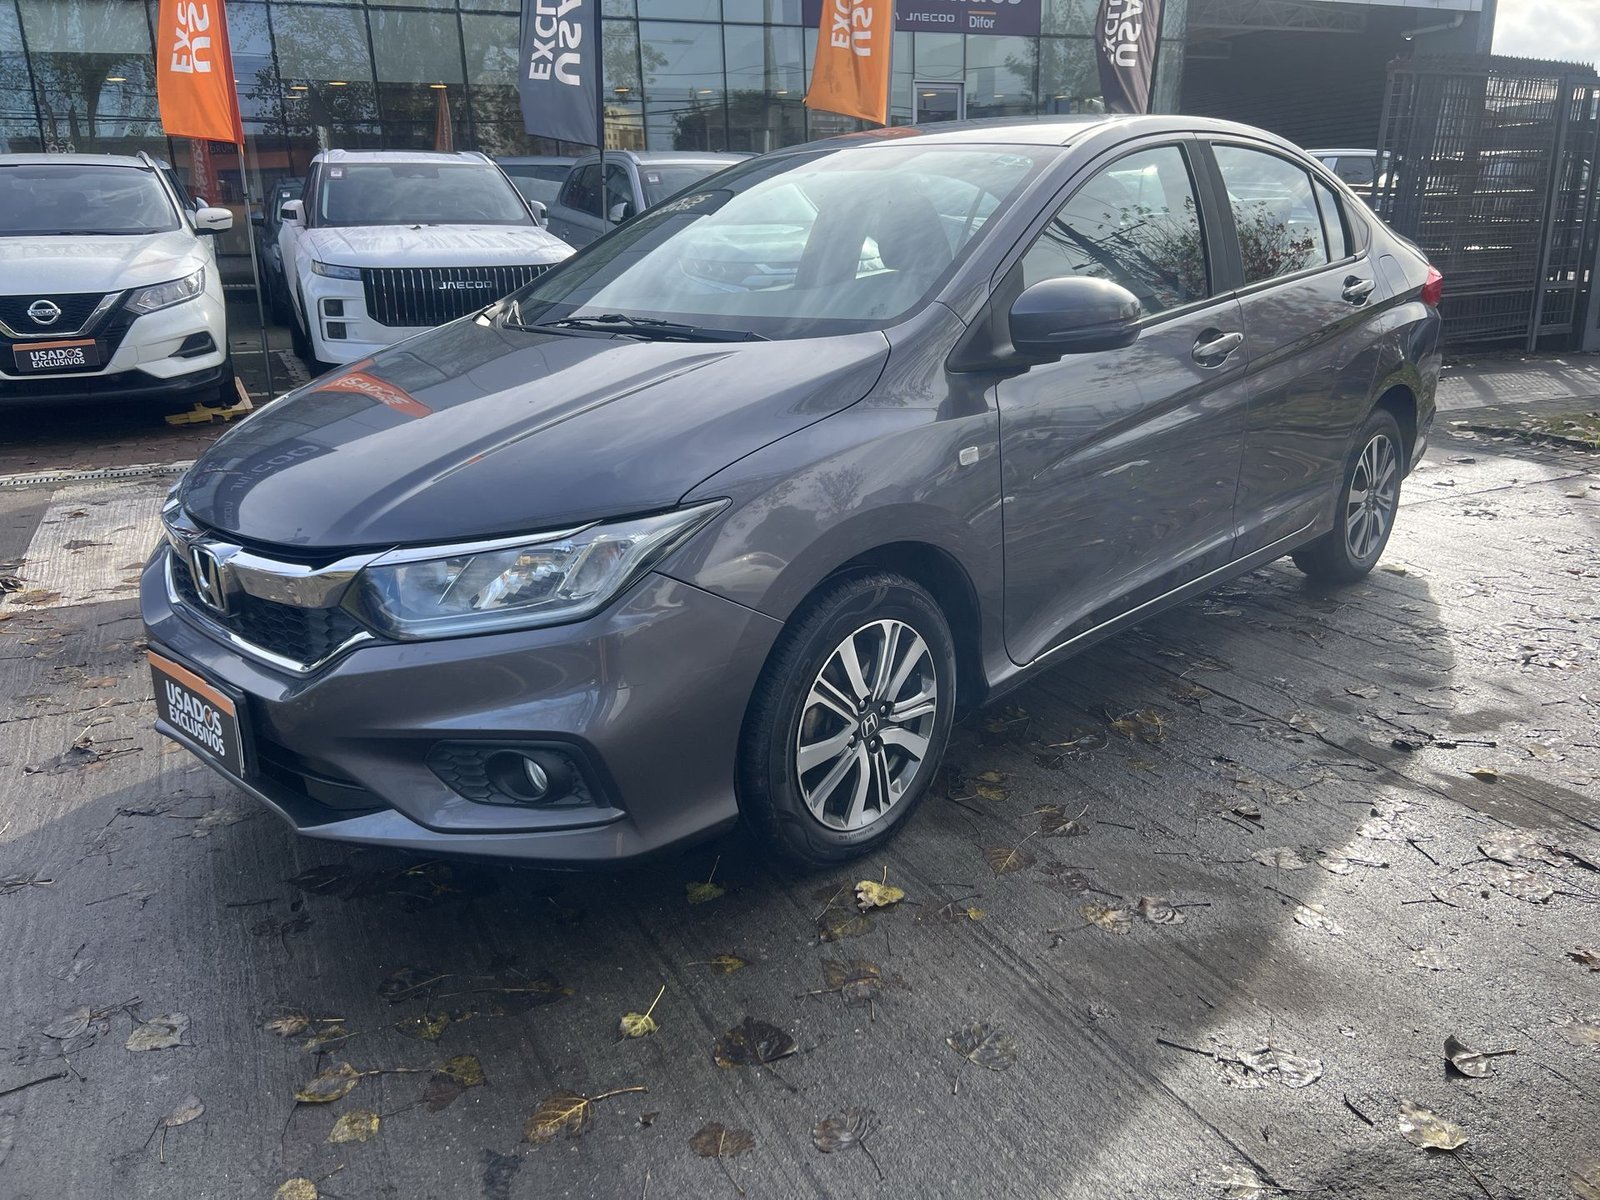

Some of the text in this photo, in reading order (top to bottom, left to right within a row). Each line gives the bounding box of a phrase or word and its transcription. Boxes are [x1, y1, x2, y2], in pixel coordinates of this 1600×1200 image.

[905, 12, 955, 22] JAECOO
[968, 15, 995, 28] Difor
[438, 281, 493, 289] JAECOO
[30, 348, 84, 361] USADOS
[32, 357, 86, 368] EXCLUSIVOS
[165, 680, 222, 736] USADOS
[168, 704, 226, 756] EXCLUSIVOS
